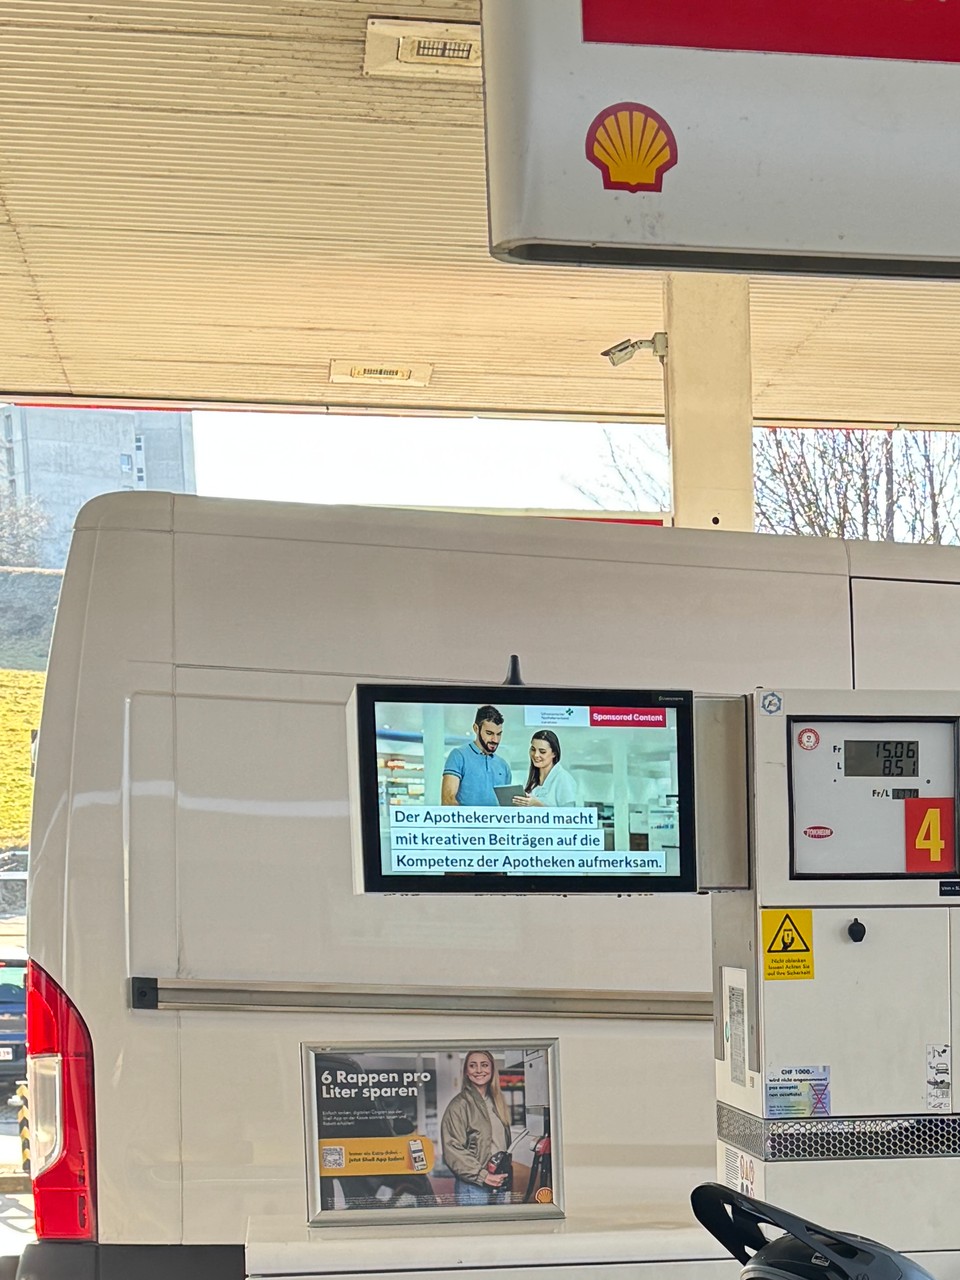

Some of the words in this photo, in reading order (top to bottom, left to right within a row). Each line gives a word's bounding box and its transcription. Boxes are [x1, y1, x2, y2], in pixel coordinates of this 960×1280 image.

[593, 713, 633, 722] Sponsored
[633, 714, 663, 722] Content
[833, 745, 842, 753] Fr
[876, 742, 916, 759] 15.06
[837, 762, 842, 770] L
[882, 759, 916, 776] 8.51
[872, 789, 890, 798] Fr/L
[395, 811, 420, 824] Der
[423, 810, 550, 827] Apothekerverband
[553, 812, 594, 826] macht
[395, 833, 419, 846] mit
[421, 833, 486, 846] kreativen
[489, 833, 554, 849] Beiträgen
[556, 834, 579, 847] auf
[580, 834, 601, 847] die
[915, 808, 945, 862] 4
[396, 855, 474, 872] Kompetenz
[476, 855, 500, 869] der
[502, 856, 575, 872] Apotheken
[578, 856, 663, 869] aufmerksam.
[321, 1070, 332, 1084] 6
[336, 1070, 399, 1086] Rappen
[403, 1072, 431, 1086] pro
[322, 1085, 358, 1098] Liter
